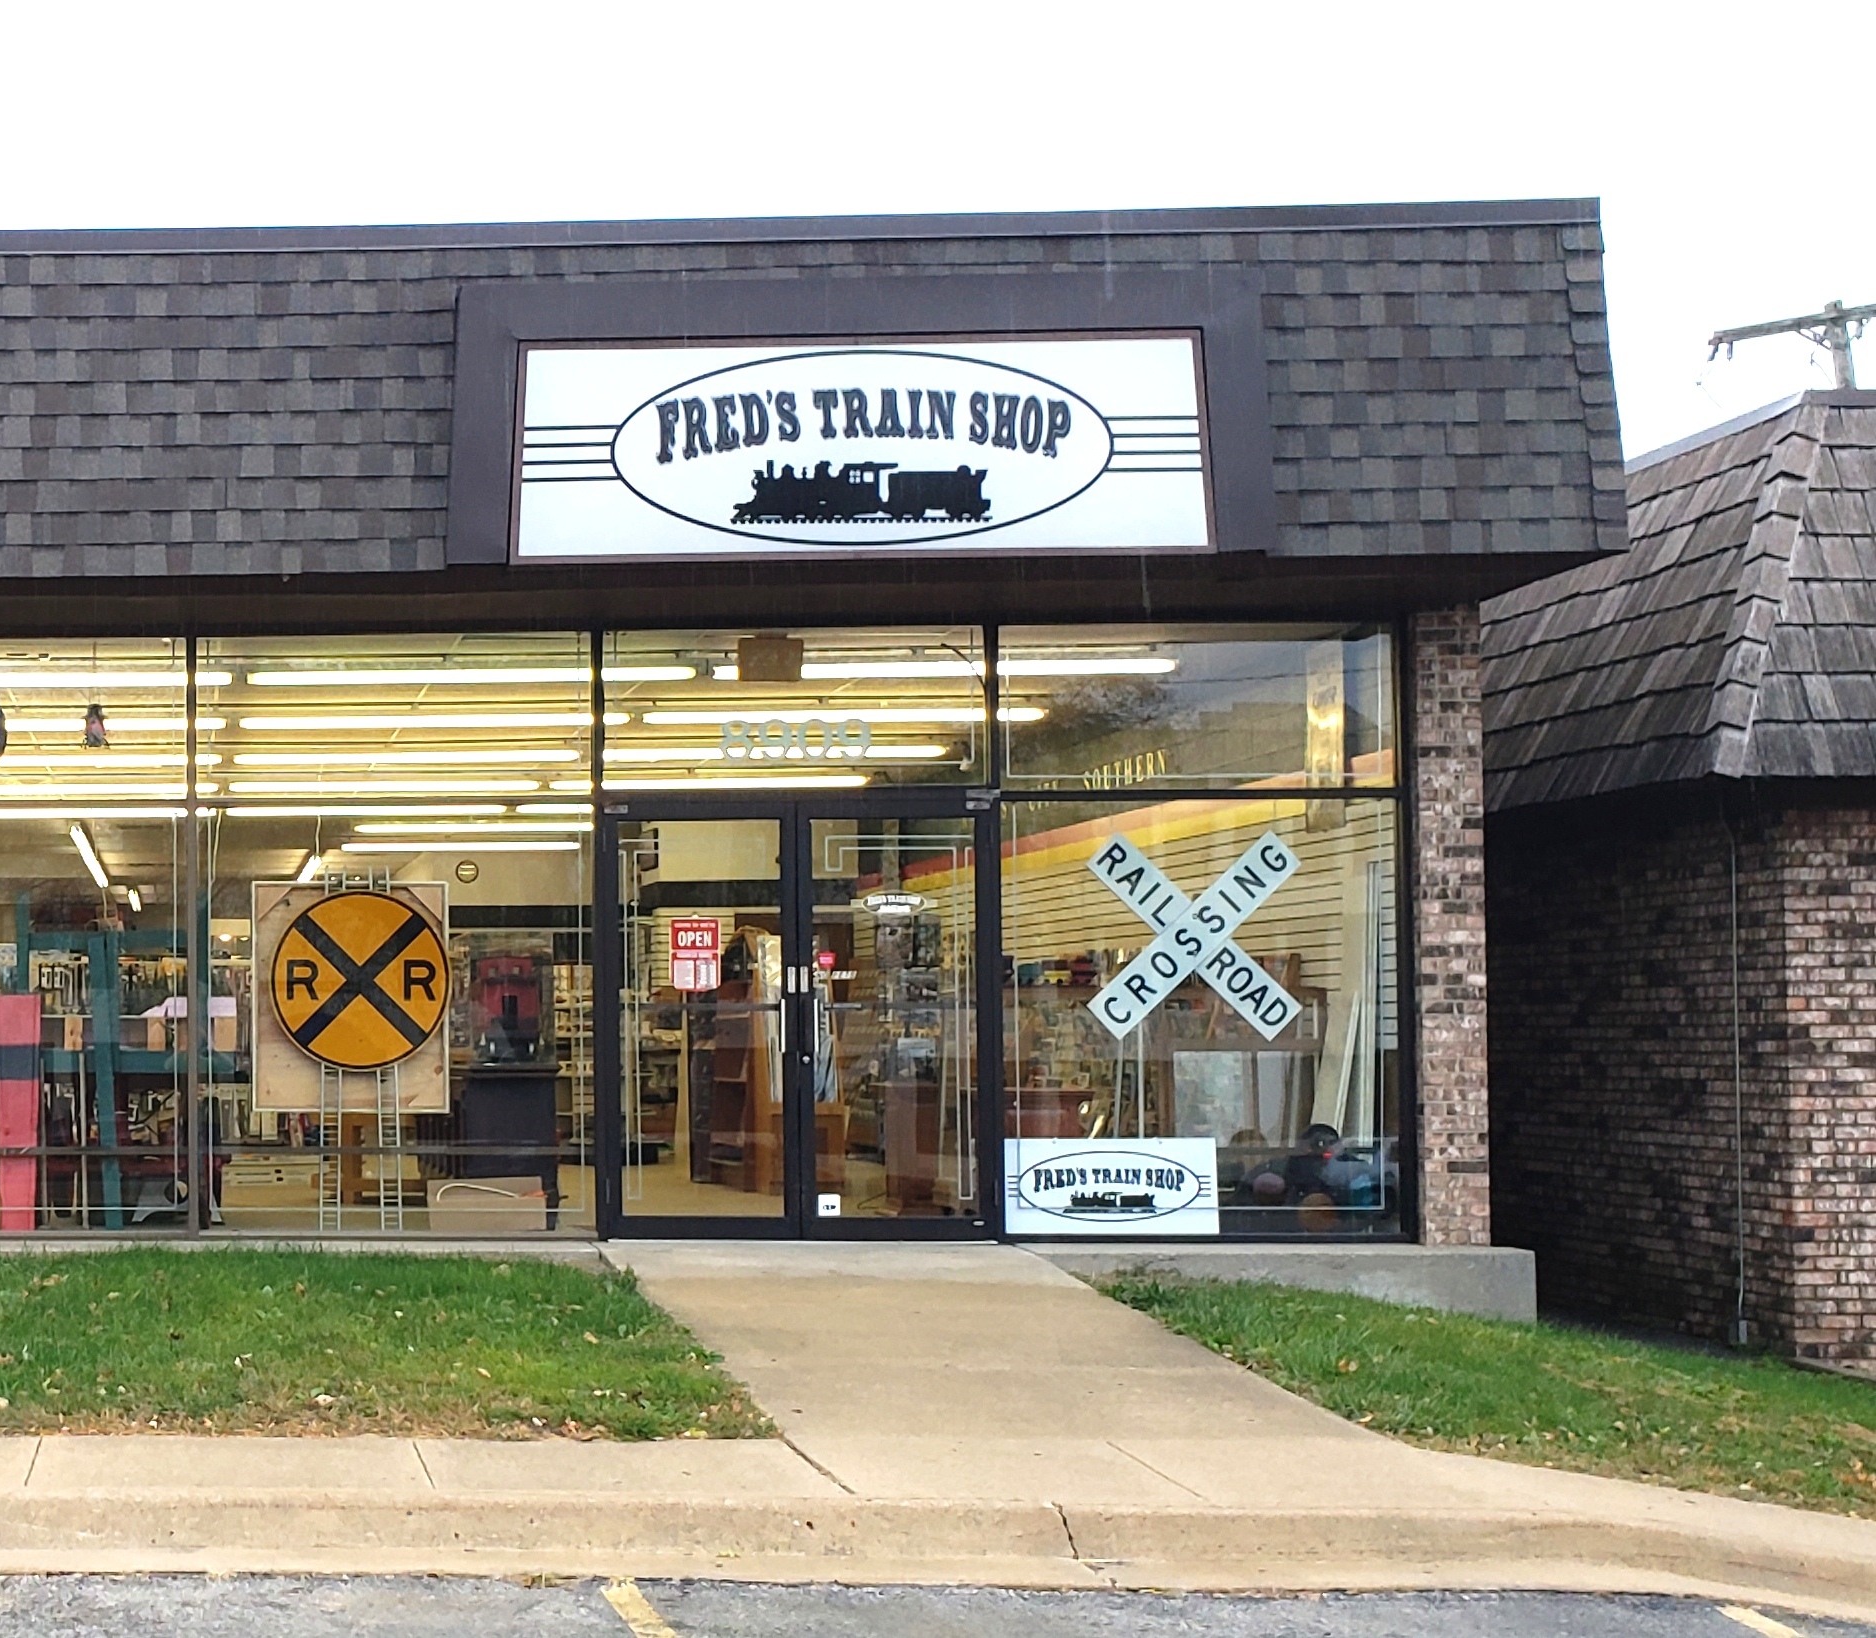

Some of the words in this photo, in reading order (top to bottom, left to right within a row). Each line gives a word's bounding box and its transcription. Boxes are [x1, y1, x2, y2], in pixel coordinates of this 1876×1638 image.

[655, 390, 801, 465] FRED'S
[813, 388, 957, 440] TRAIN
[968, 391, 1071, 459] SHOP
[719, 719, 872, 760] 8909
[1083, 749, 1166, 790] SOUTHERN
[1097, 842, 1174, 927] RAIL
[677, 930, 713, 948] OPEN
[1103, 845, 1287, 1025] CROSSING
[286, 959, 319, 1001] R
[403, 959, 437, 1001] R
[1206, 948, 1288, 1026] ROAD
[1033, 1167, 1088, 1193] FRED'S
[1091, 1168, 1142, 1185] TRAIN
[1145, 1167, 1186, 1192] SHOP
